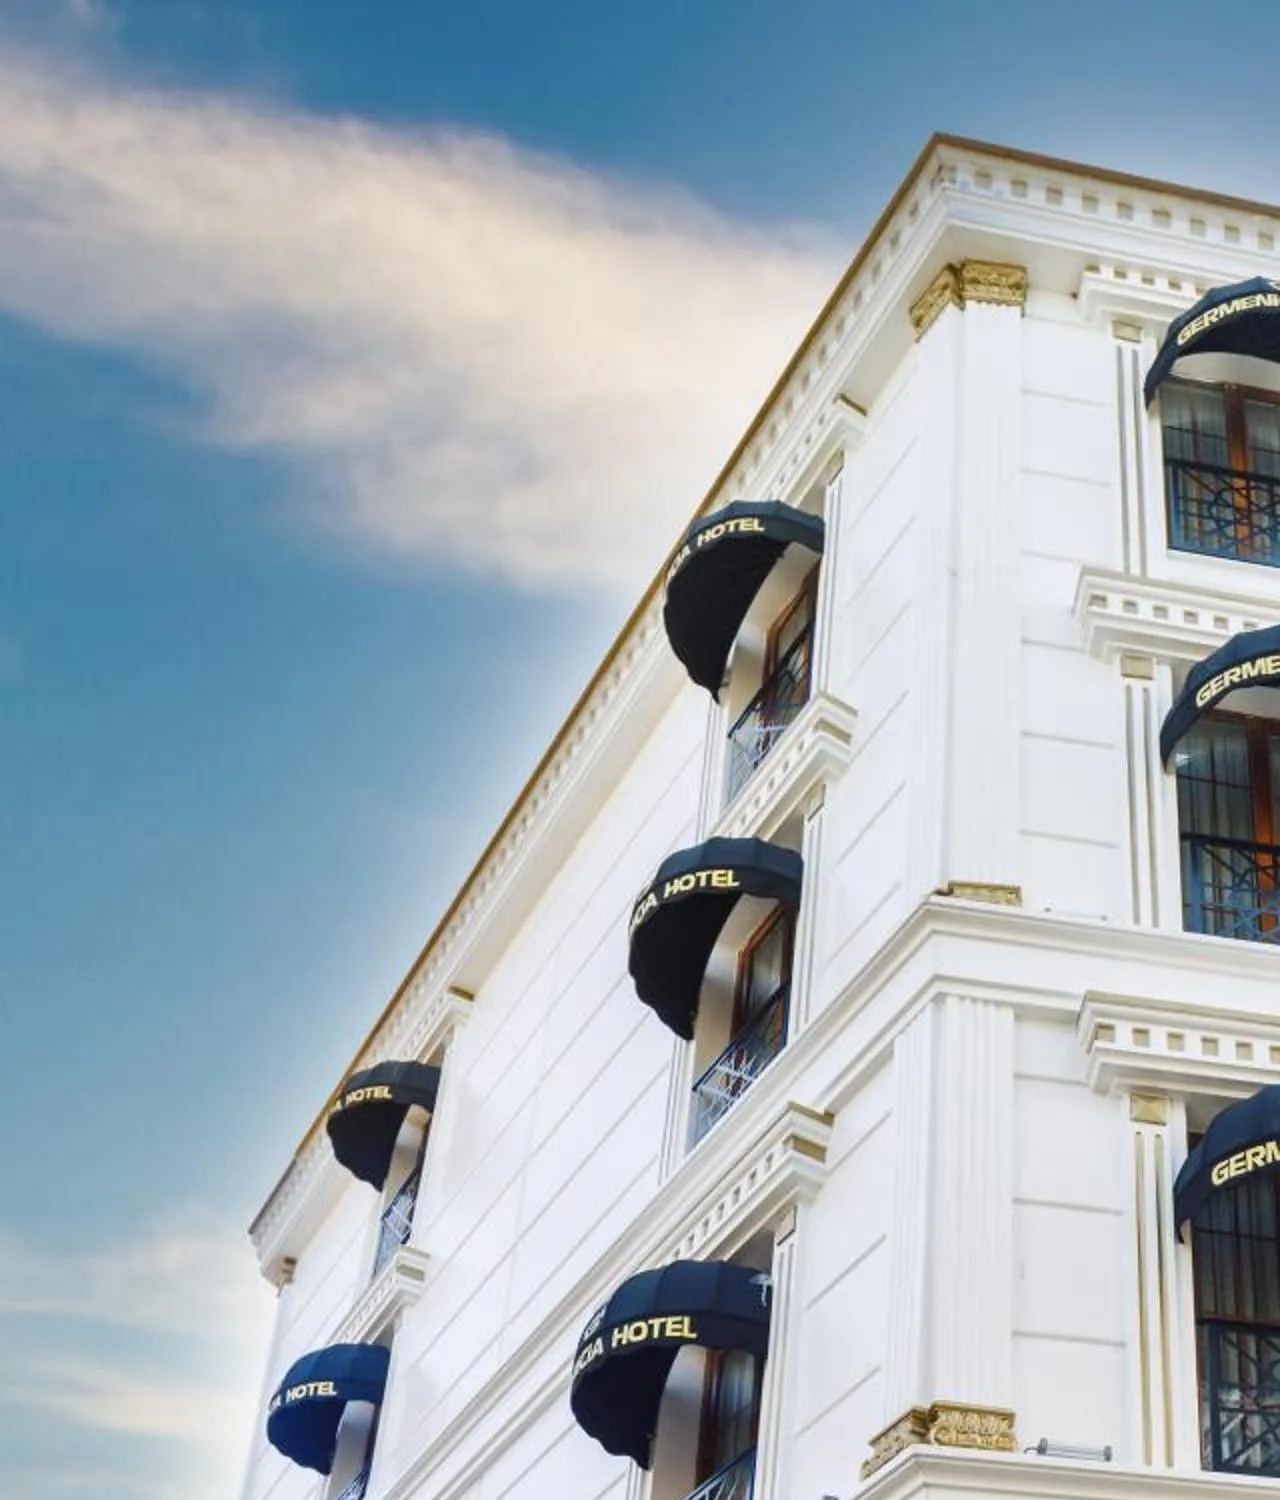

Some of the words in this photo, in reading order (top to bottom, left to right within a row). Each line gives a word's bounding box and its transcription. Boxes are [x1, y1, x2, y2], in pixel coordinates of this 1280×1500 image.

[697, 518, 765, 547] HOTEL
[664, 869, 740, 898] HOTEL
[346, 1085, 393, 1107] HOTEL
[611, 1315, 698, 1349] HOTEL
[285, 1381, 337, 1403] HOTEL
